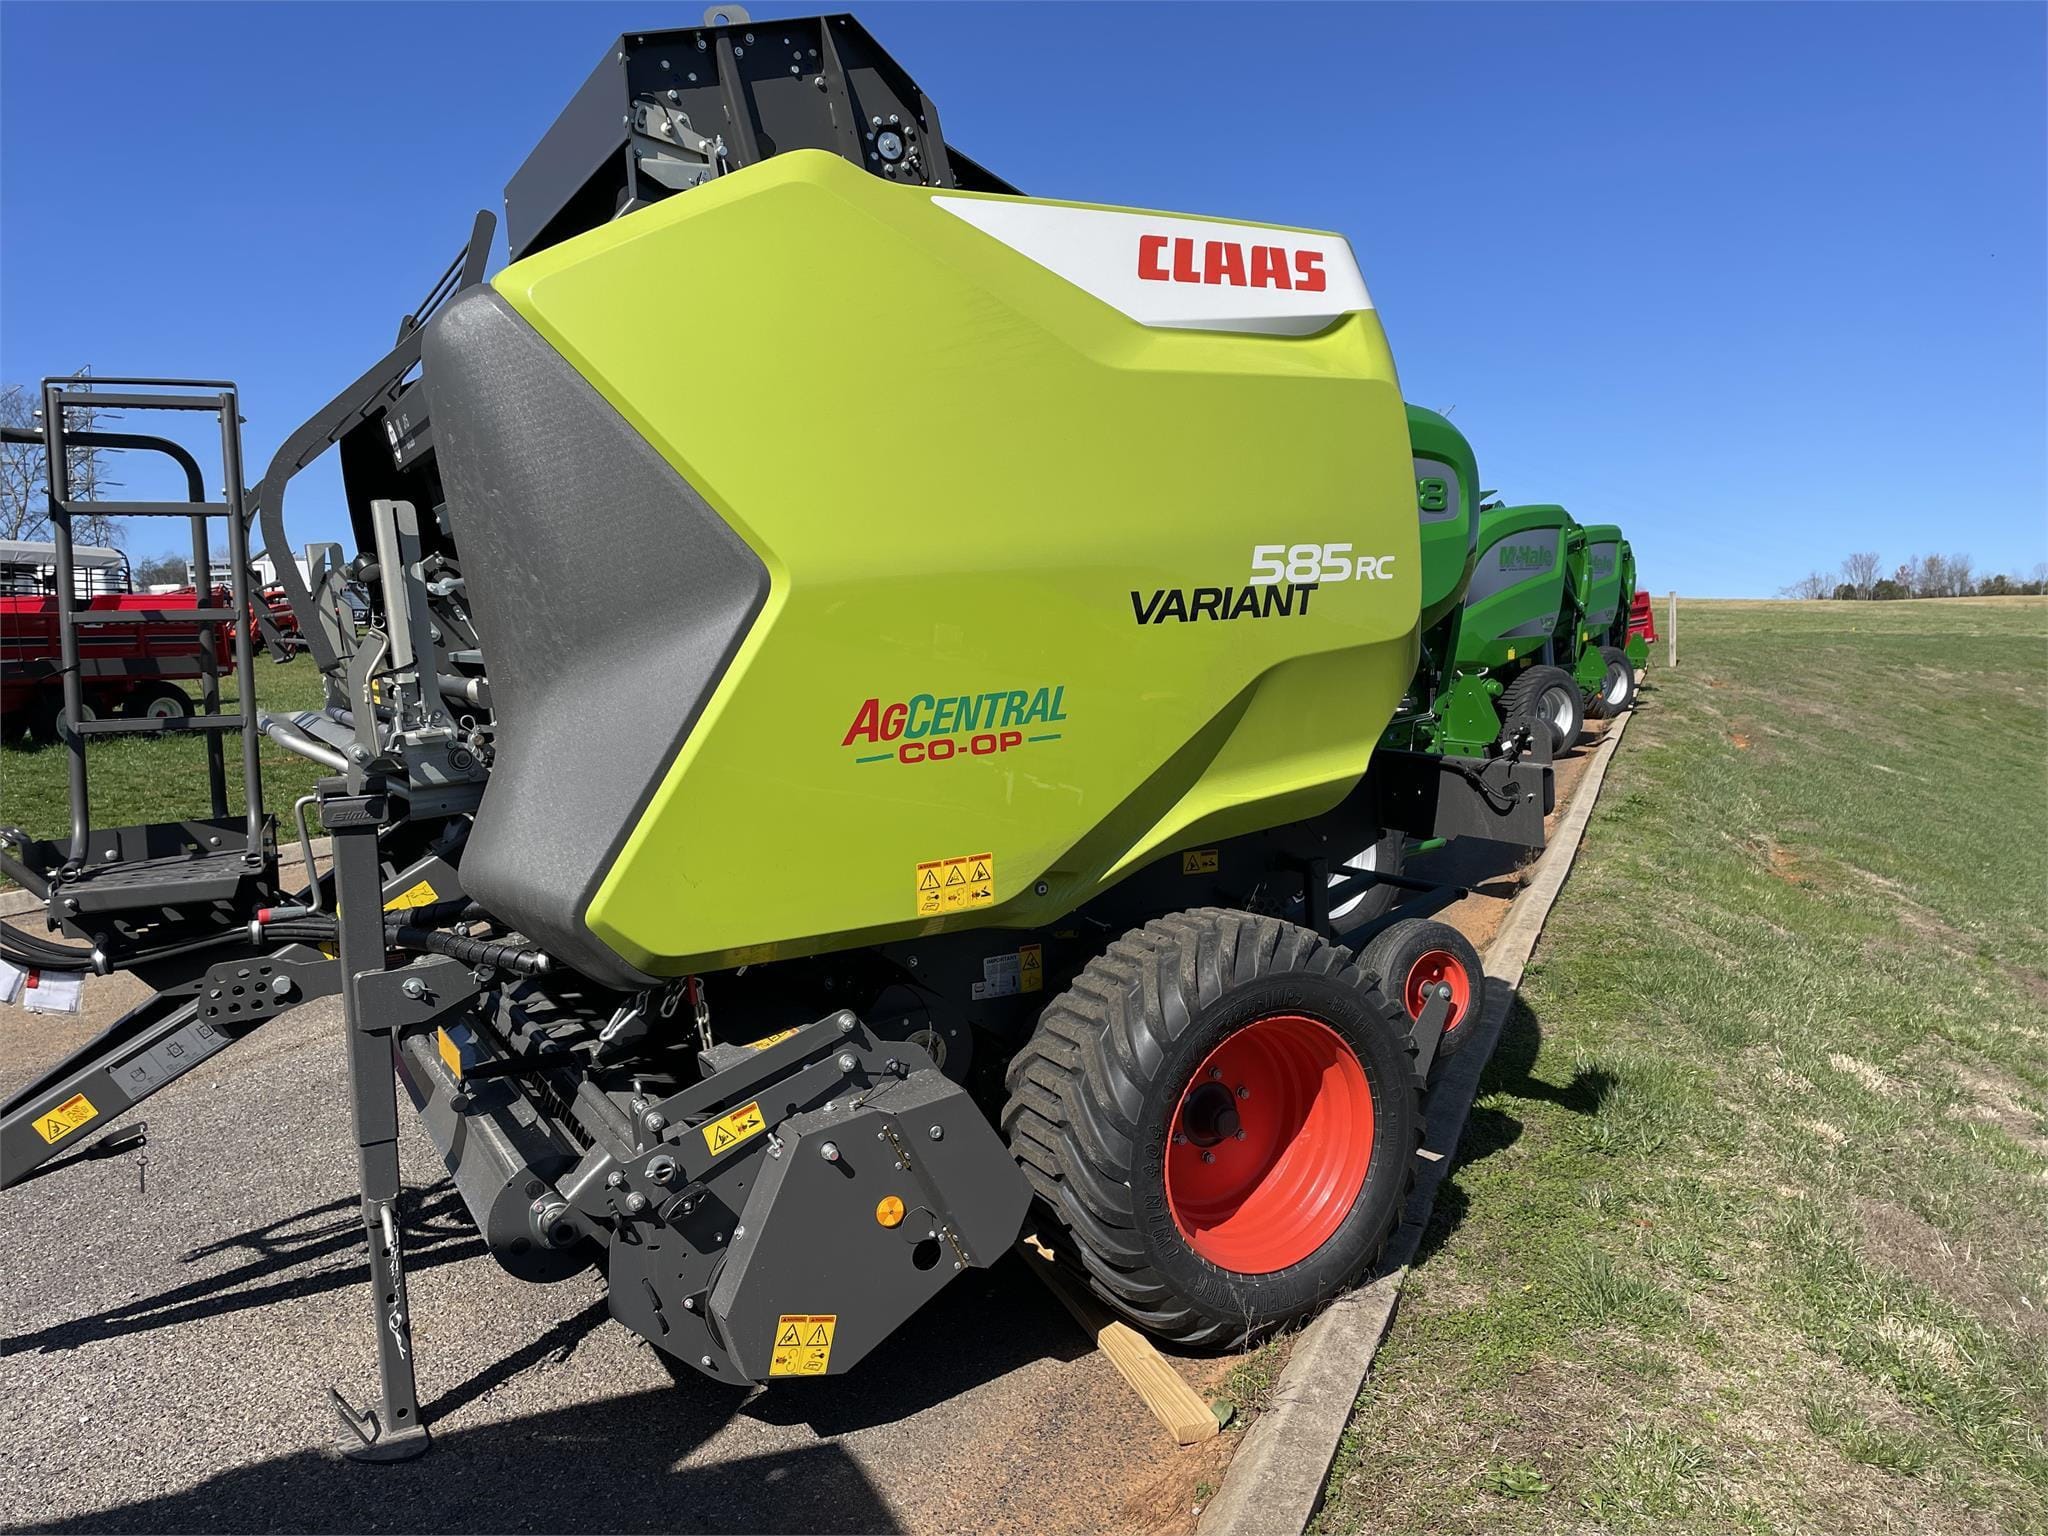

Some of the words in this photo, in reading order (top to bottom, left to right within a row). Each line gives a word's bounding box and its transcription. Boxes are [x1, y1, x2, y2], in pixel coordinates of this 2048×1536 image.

[1138, 234, 1326, 292] CLAAS
[1249, 543, 1353, 585] 585
[1355, 555, 1396, 581] RC
[1130, 583, 1319, 625] VARIANT
[898, 730, 1023, 764] CO-OP
